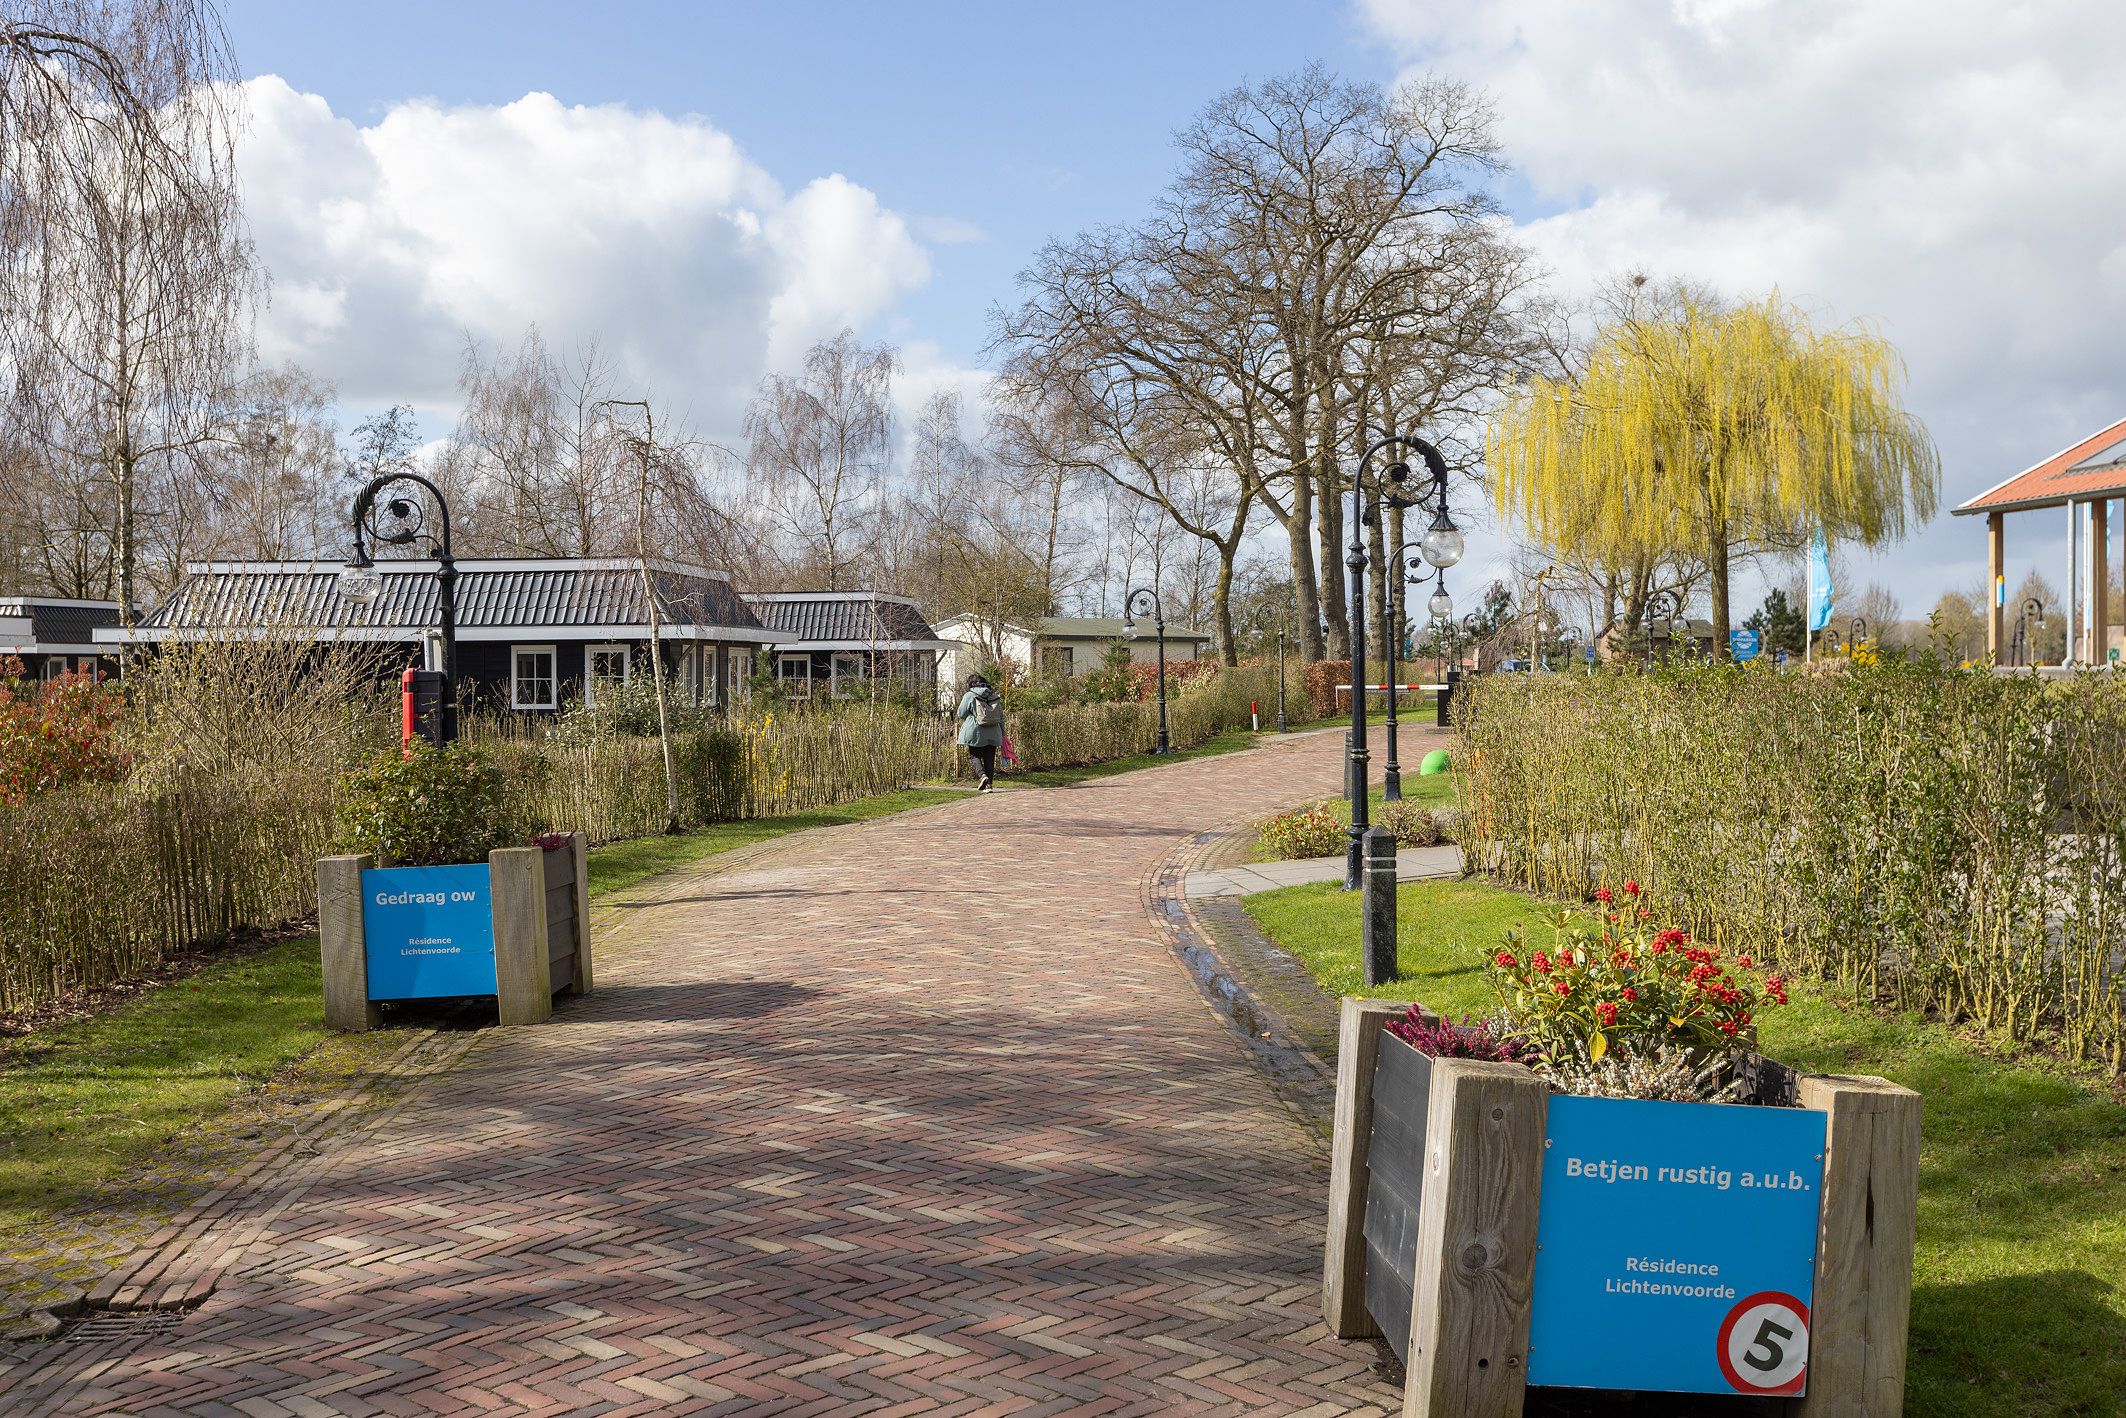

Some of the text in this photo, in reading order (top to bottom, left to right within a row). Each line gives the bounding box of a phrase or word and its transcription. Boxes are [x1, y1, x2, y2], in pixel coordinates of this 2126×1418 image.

[375, 891, 476, 906] Gedraag ow
[400, 946, 461, 956] Lichtenvoorde
[408, 937, 452, 946] Résidence
[1566, 1157, 1811, 1191] Betjen rustig a.u.b.
[1626, 1256, 1719, 1276] Résidence
[1605, 1278, 1736, 1299] Lichtenvoorde
[1743, 1317, 1794, 1372] 5
